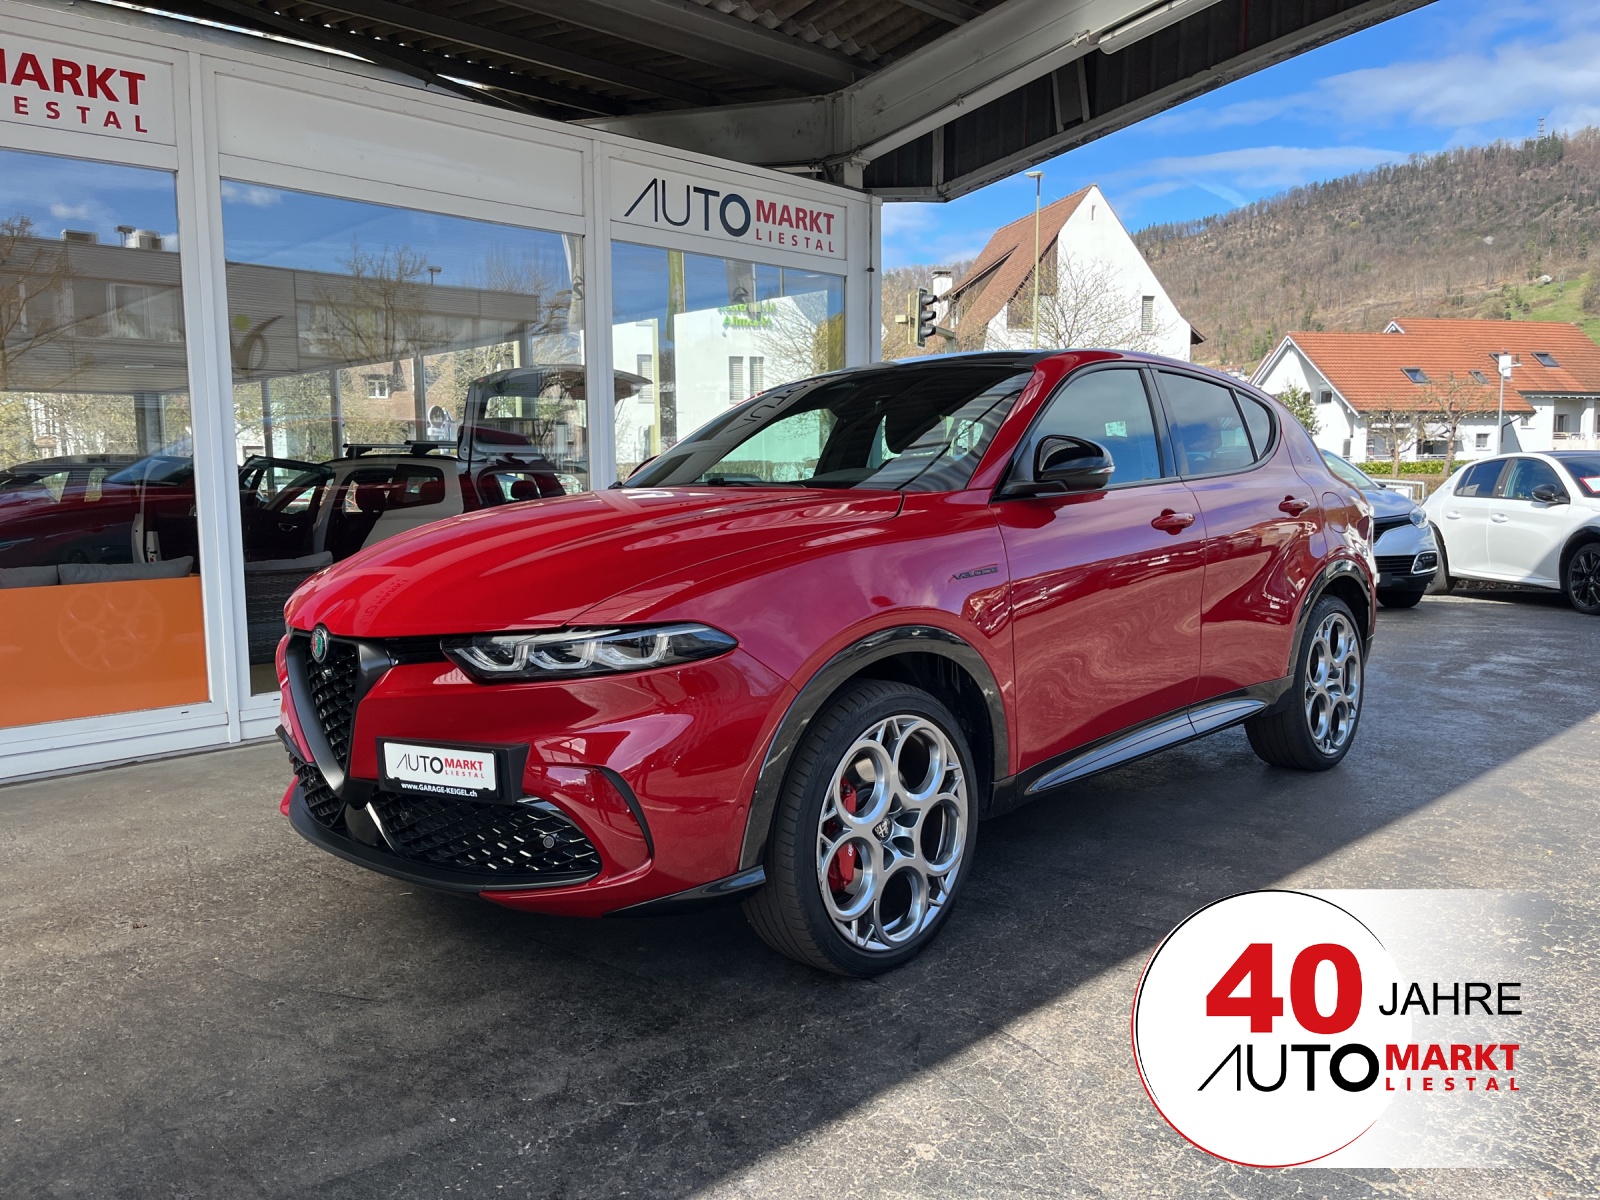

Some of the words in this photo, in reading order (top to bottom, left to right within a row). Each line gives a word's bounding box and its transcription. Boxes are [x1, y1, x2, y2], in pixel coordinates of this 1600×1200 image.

[0, 47, 146, 106] ARKT
[755, 198, 835, 236] MARKT
[755, 227, 835, 253] LIESTAL
[444, 757, 484, 771] MARKT
[445, 769, 485, 778] LIESTAL
[400, 782, 478, 798] www.GARAGE-KEIGEL.ch
